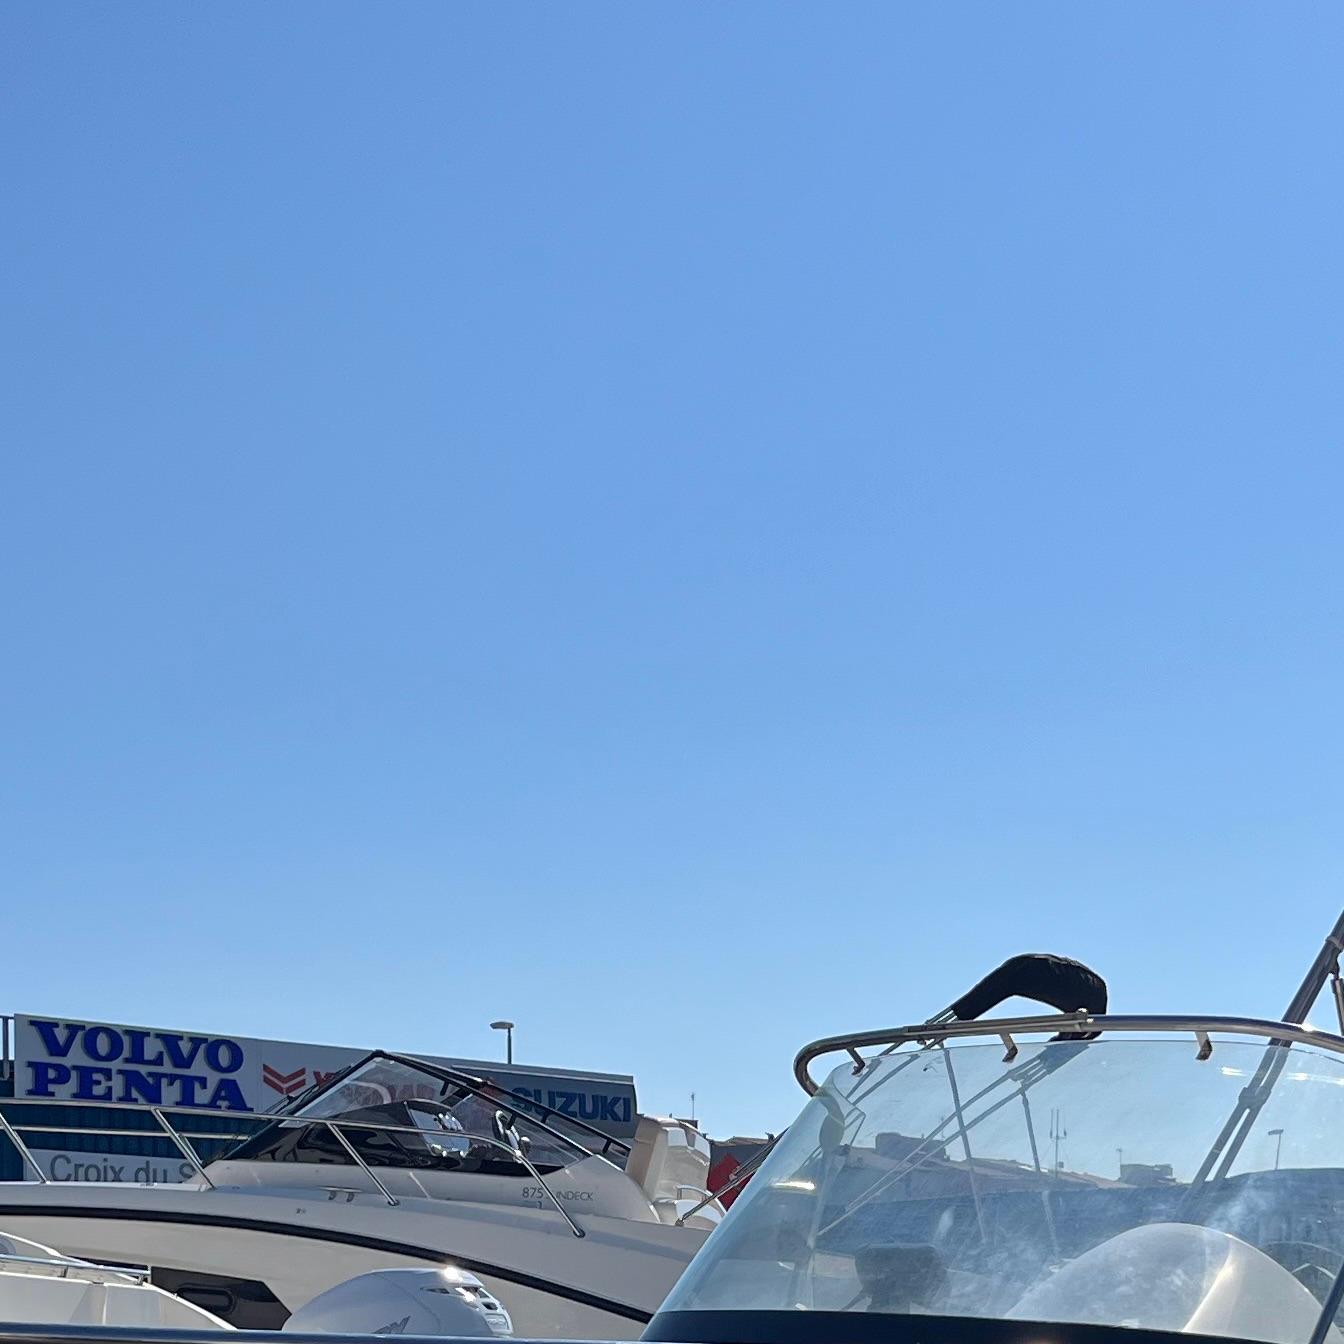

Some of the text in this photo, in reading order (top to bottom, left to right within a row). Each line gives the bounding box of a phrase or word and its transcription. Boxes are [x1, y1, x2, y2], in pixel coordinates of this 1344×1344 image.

[29, 1020, 244, 1073] VOLVO
[25, 1061, 254, 1112] PENTA
[511, 1087, 631, 1123] SUZUKI
[50, 1154, 122, 1183] Croix
[135, 1160, 168, 1184] du
[522, 1187, 544, 1199] 875
